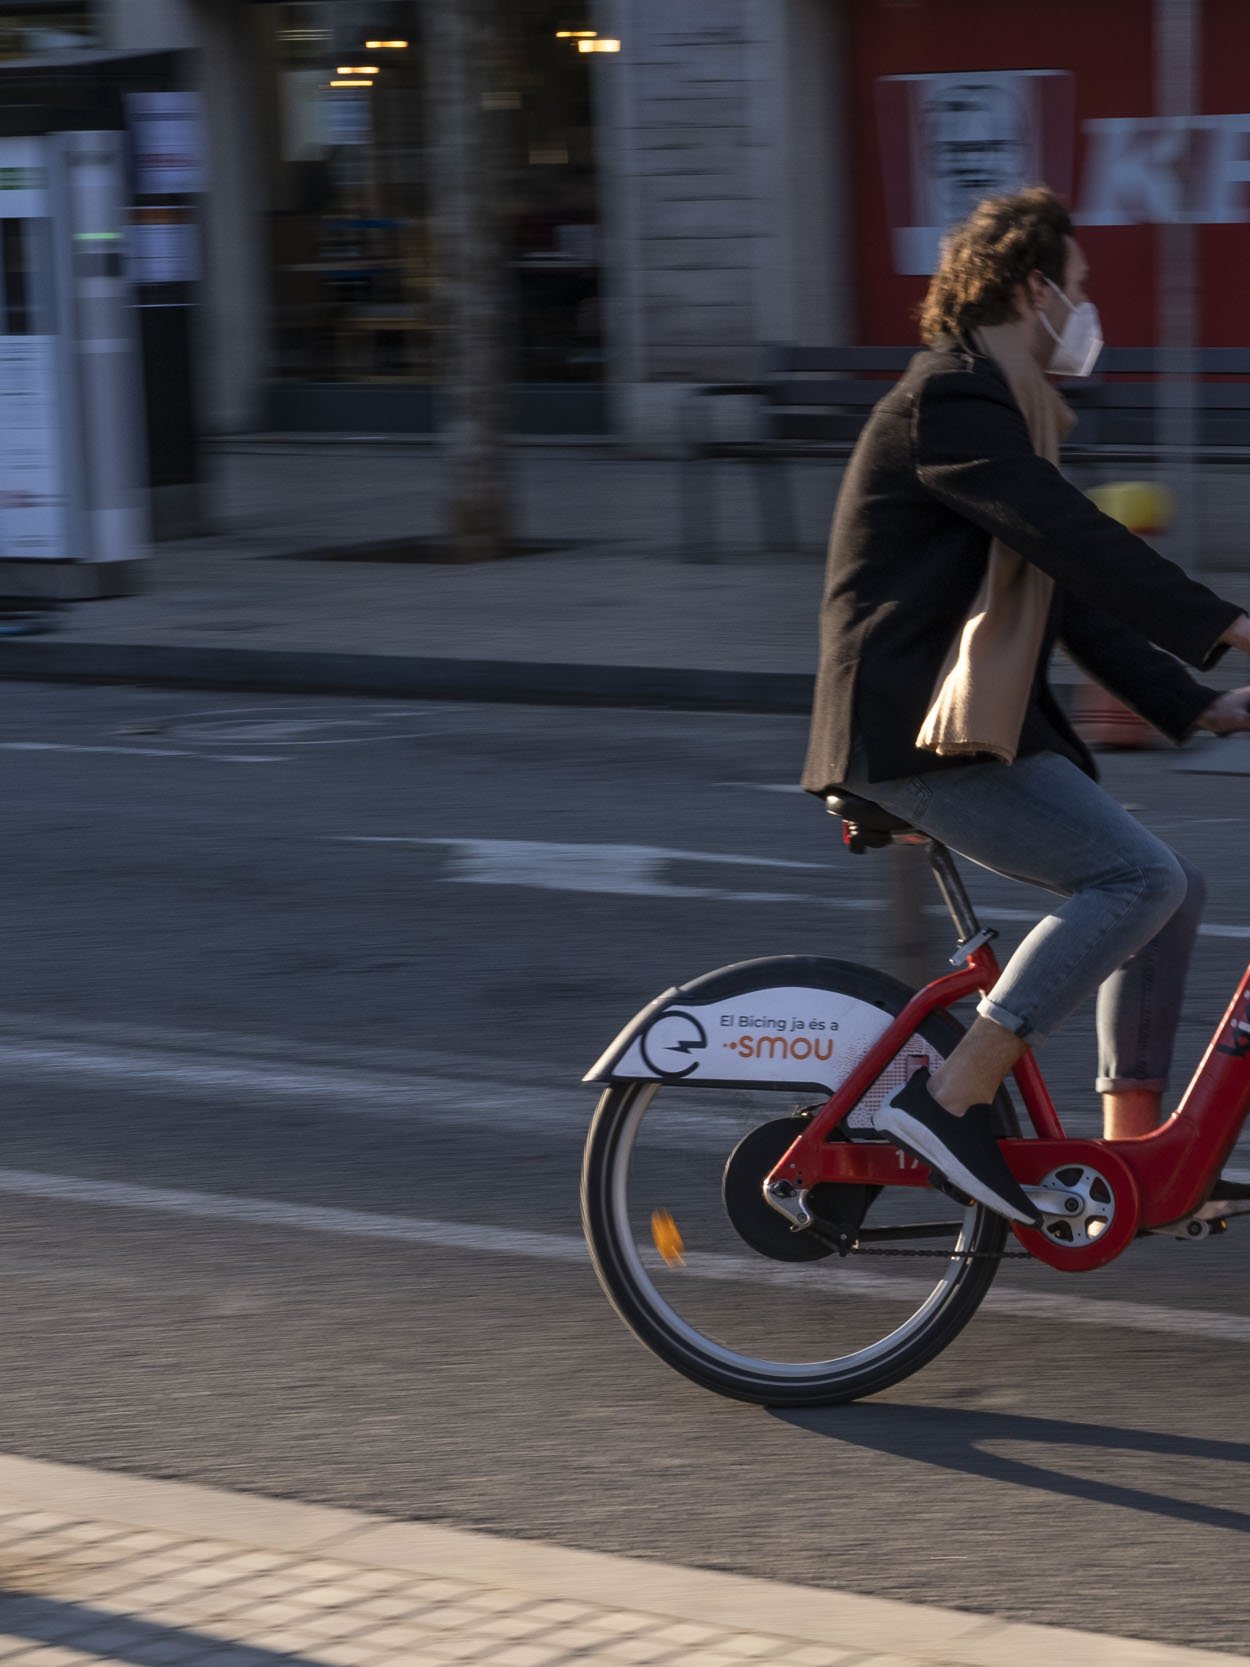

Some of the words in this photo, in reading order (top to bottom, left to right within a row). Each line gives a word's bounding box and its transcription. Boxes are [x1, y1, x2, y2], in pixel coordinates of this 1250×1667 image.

[720, 1015, 734, 1027] El
[738, 1015, 786, 1032] Bicing
[789, 1016, 805, 1032] ja
[808, 1018, 826, 1030] és
[830, 1021, 839, 1031] a
[738, 1035, 834, 1061] smou
